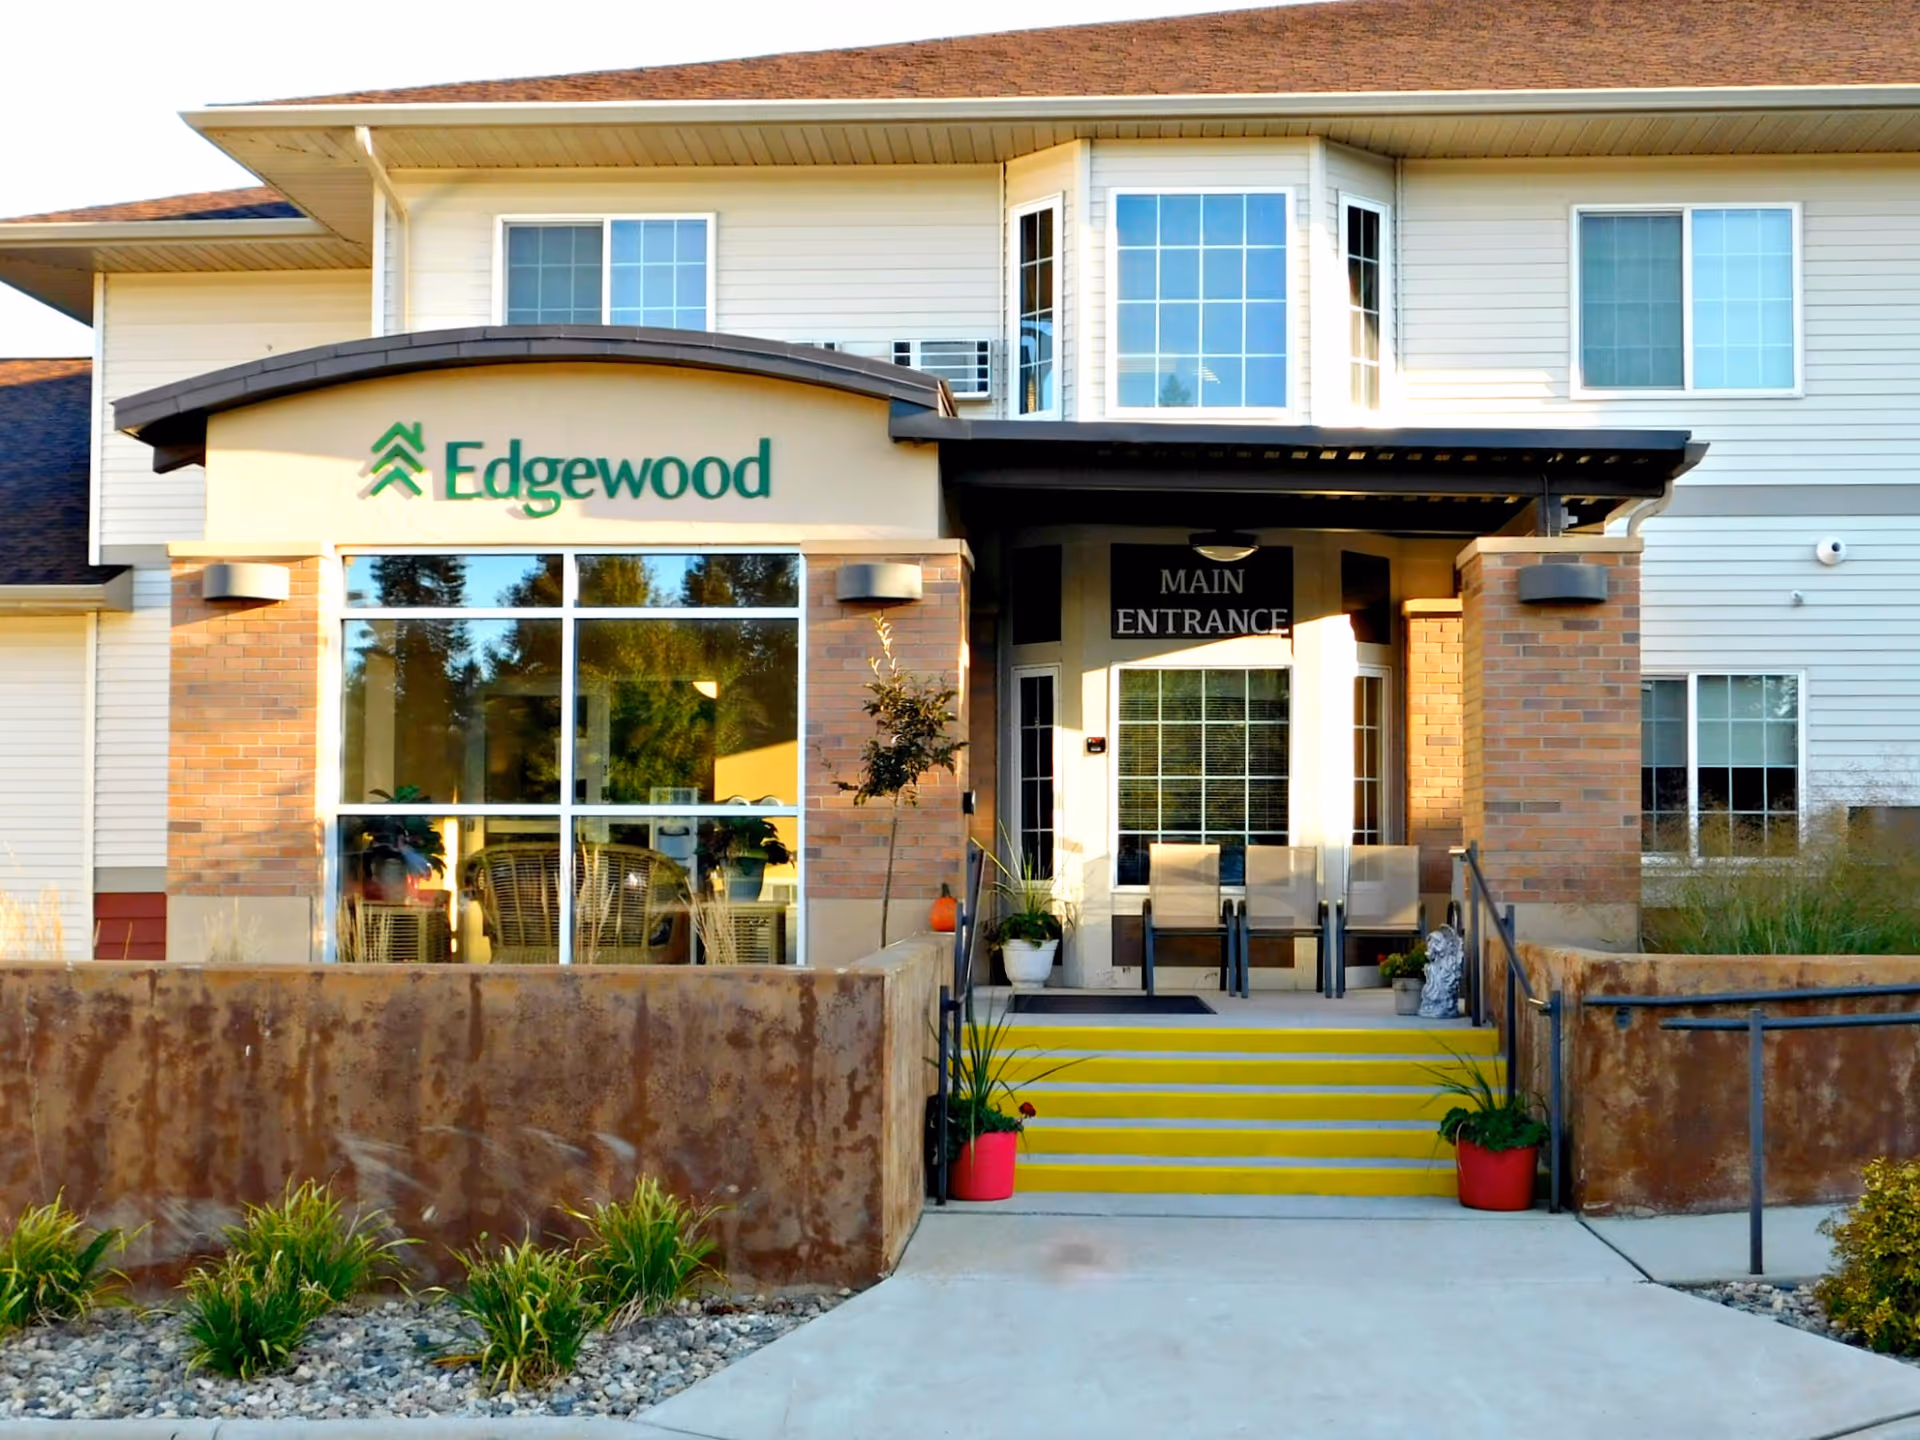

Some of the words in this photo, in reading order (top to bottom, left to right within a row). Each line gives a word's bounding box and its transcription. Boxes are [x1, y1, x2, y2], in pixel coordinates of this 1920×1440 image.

[445, 437, 771, 518] Edgewood
[1160, 569, 1245, 594] MAIN
[1116, 608, 1290, 634] ENTRANCE
